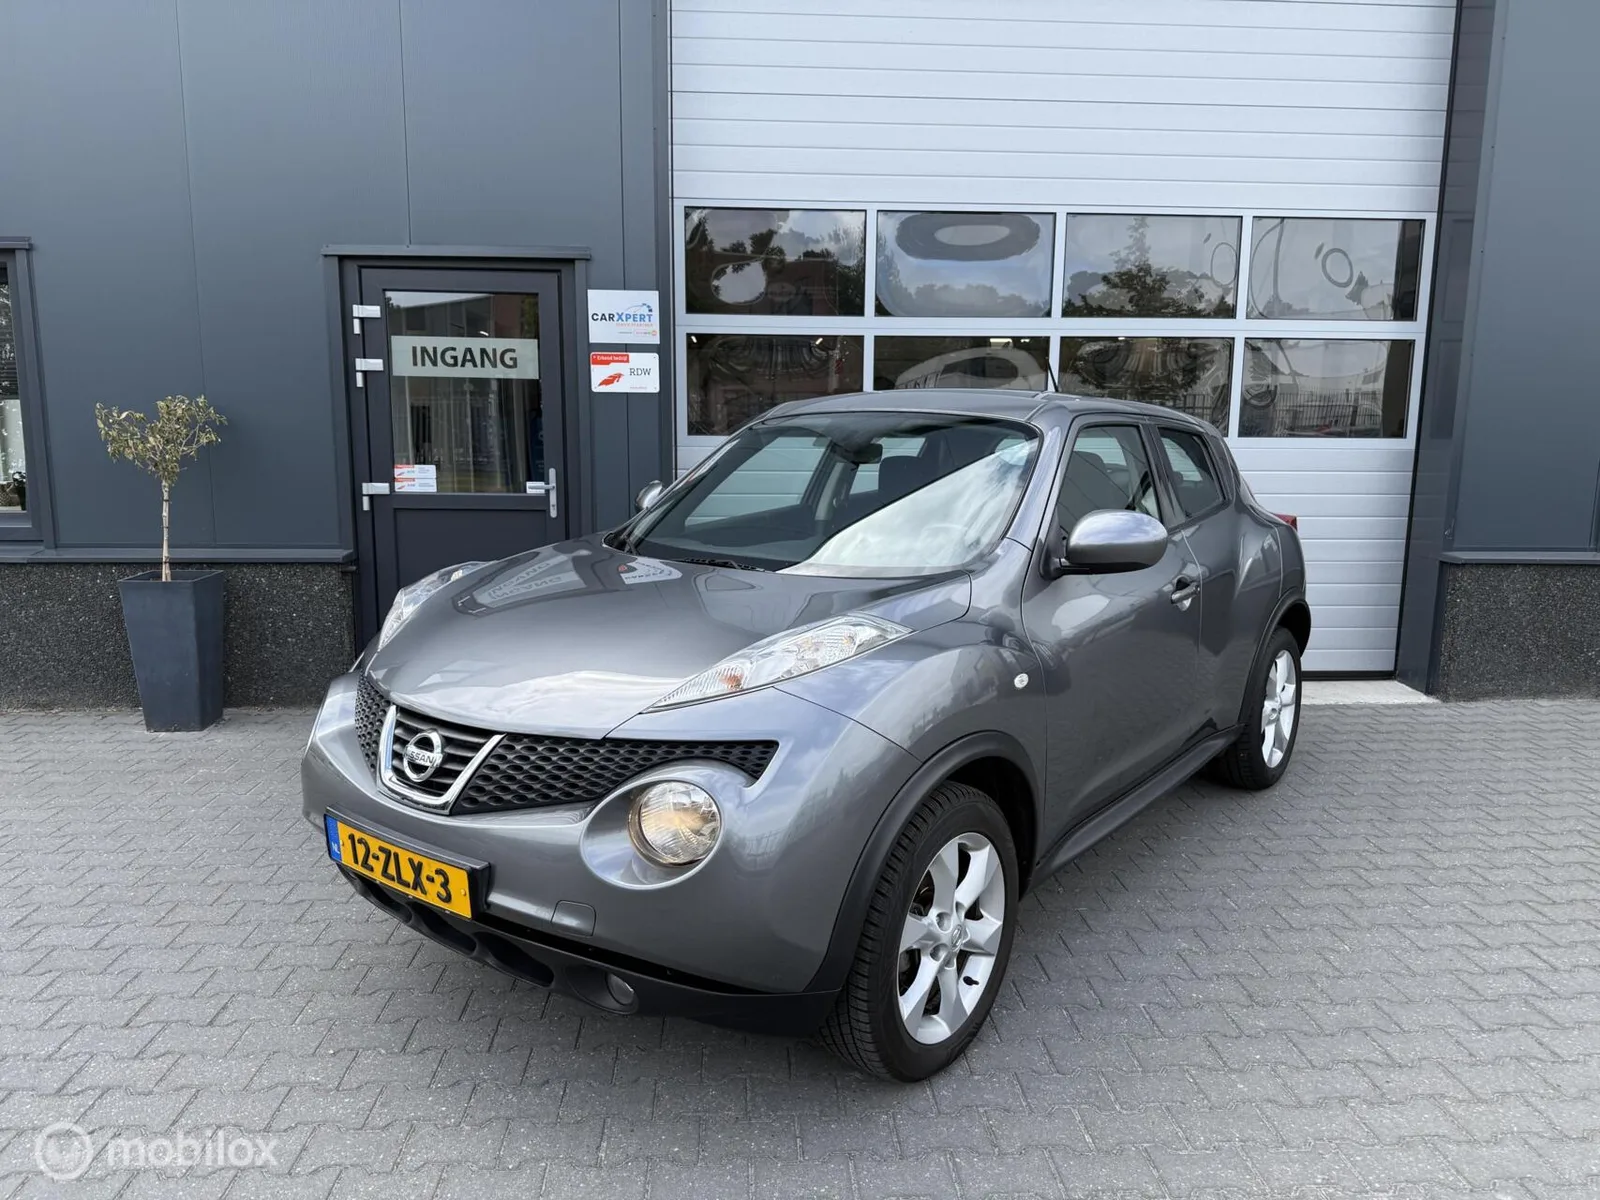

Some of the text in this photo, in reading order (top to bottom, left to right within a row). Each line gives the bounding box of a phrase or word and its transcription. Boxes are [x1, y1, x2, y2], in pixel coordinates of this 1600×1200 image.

[591, 312, 653, 322] CARXPERT
[412, 346, 518, 369] INGANG
[629, 367, 652, 376] RDW
[404, 749, 435, 765] SSAN
[331, 842, 341, 854] NL
[348, 833, 452, 904] 12-ZLX-3
